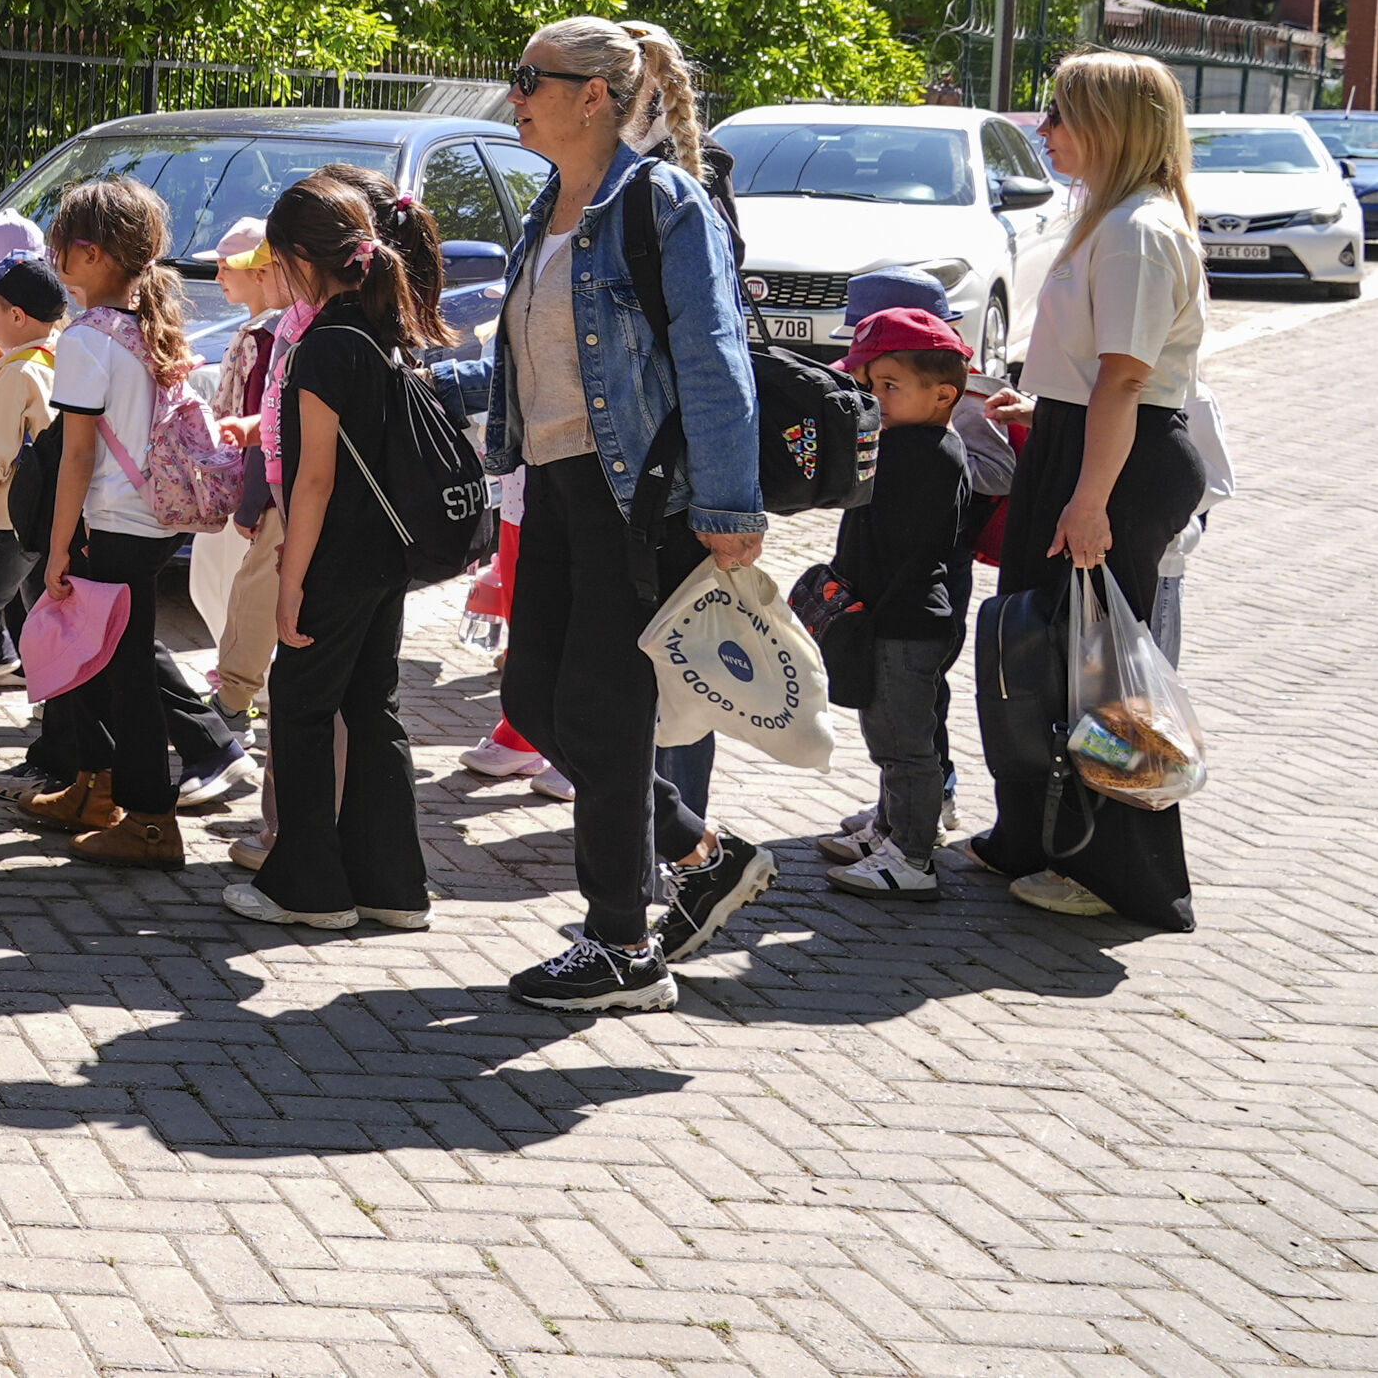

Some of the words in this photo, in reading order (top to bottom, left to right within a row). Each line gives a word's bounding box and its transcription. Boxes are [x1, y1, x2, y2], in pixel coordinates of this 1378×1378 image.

[774, 320, 807, 337] 708
[664, 628, 688, 665] DAY
[721, 654, 750, 670] NIVEA
[682, 669, 734, 712] GOOD
[777, 650, 800, 709] GOOD
[751, 706, 794, 730] MOOD
